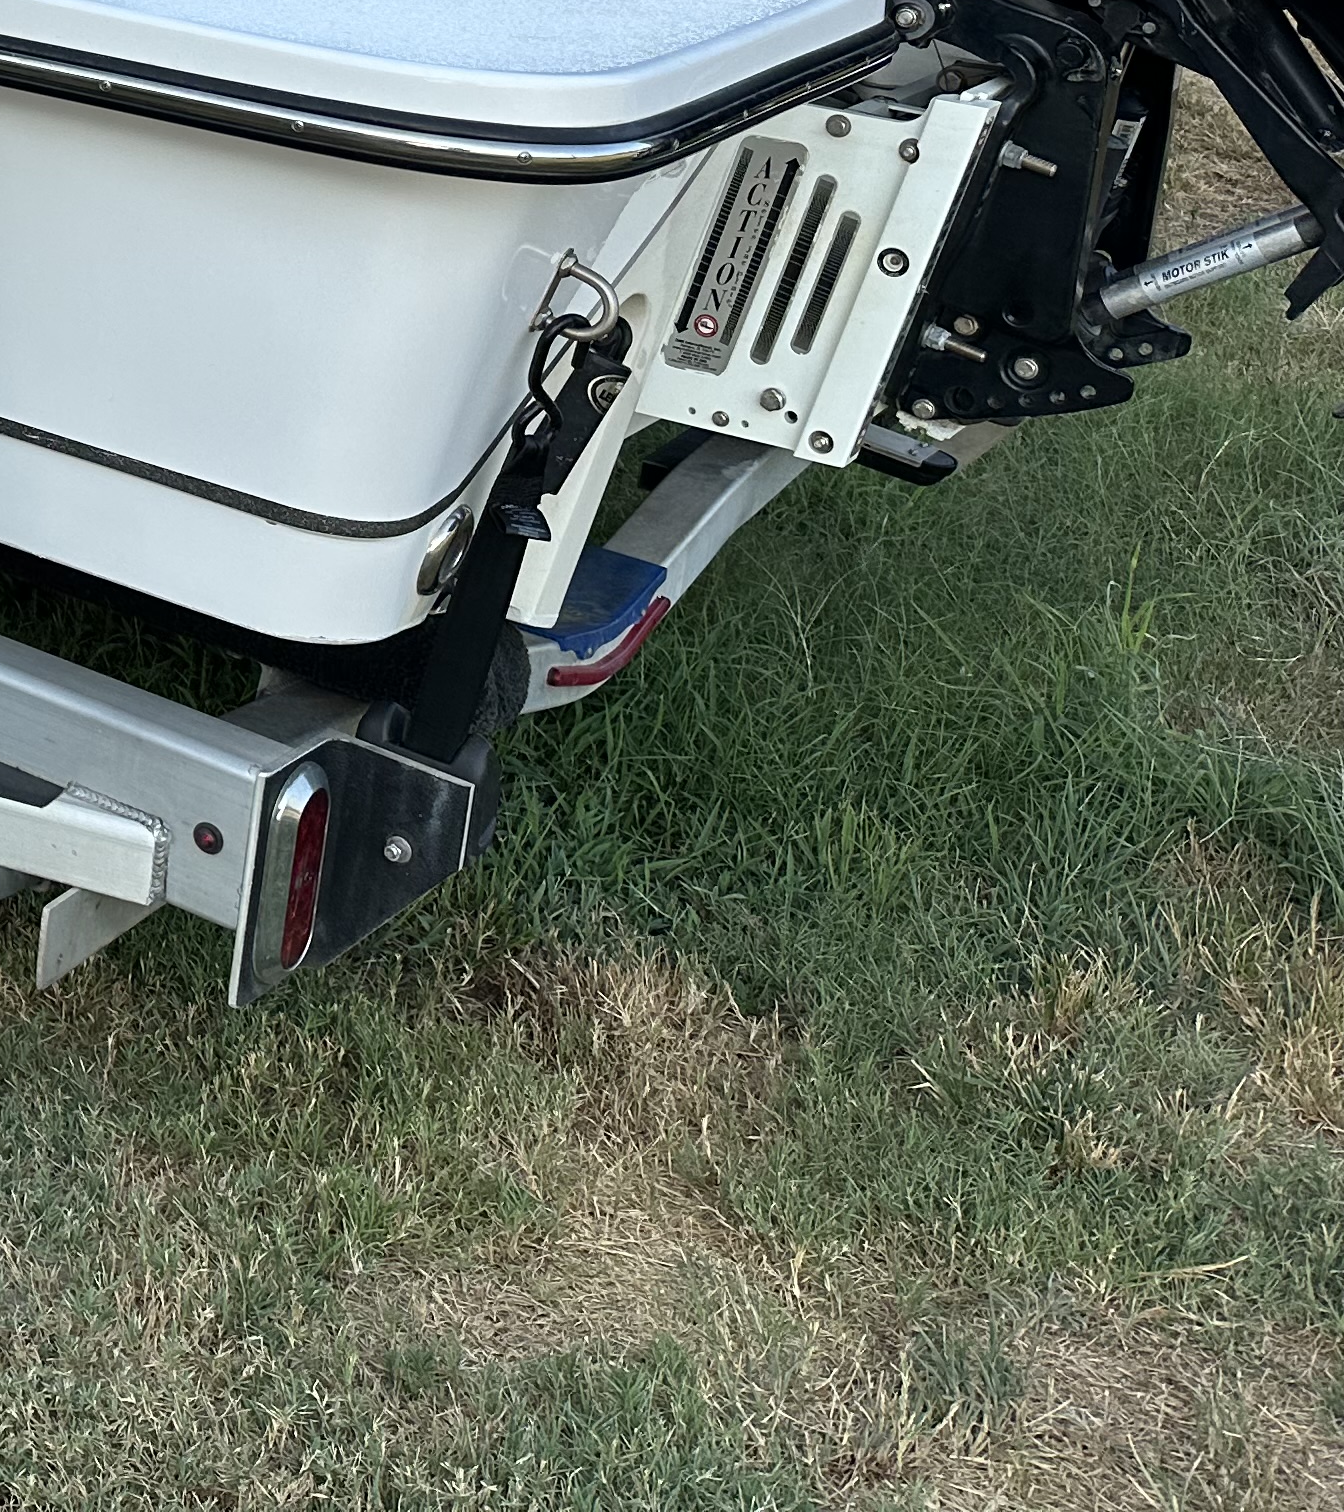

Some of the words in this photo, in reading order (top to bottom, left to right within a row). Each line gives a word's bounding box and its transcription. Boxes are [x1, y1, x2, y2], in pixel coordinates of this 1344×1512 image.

[702, 156, 772, 312] ACTION
[1161, 258, 1201, 283] MOTOR
[1203, 248, 1230, 268] STIK
